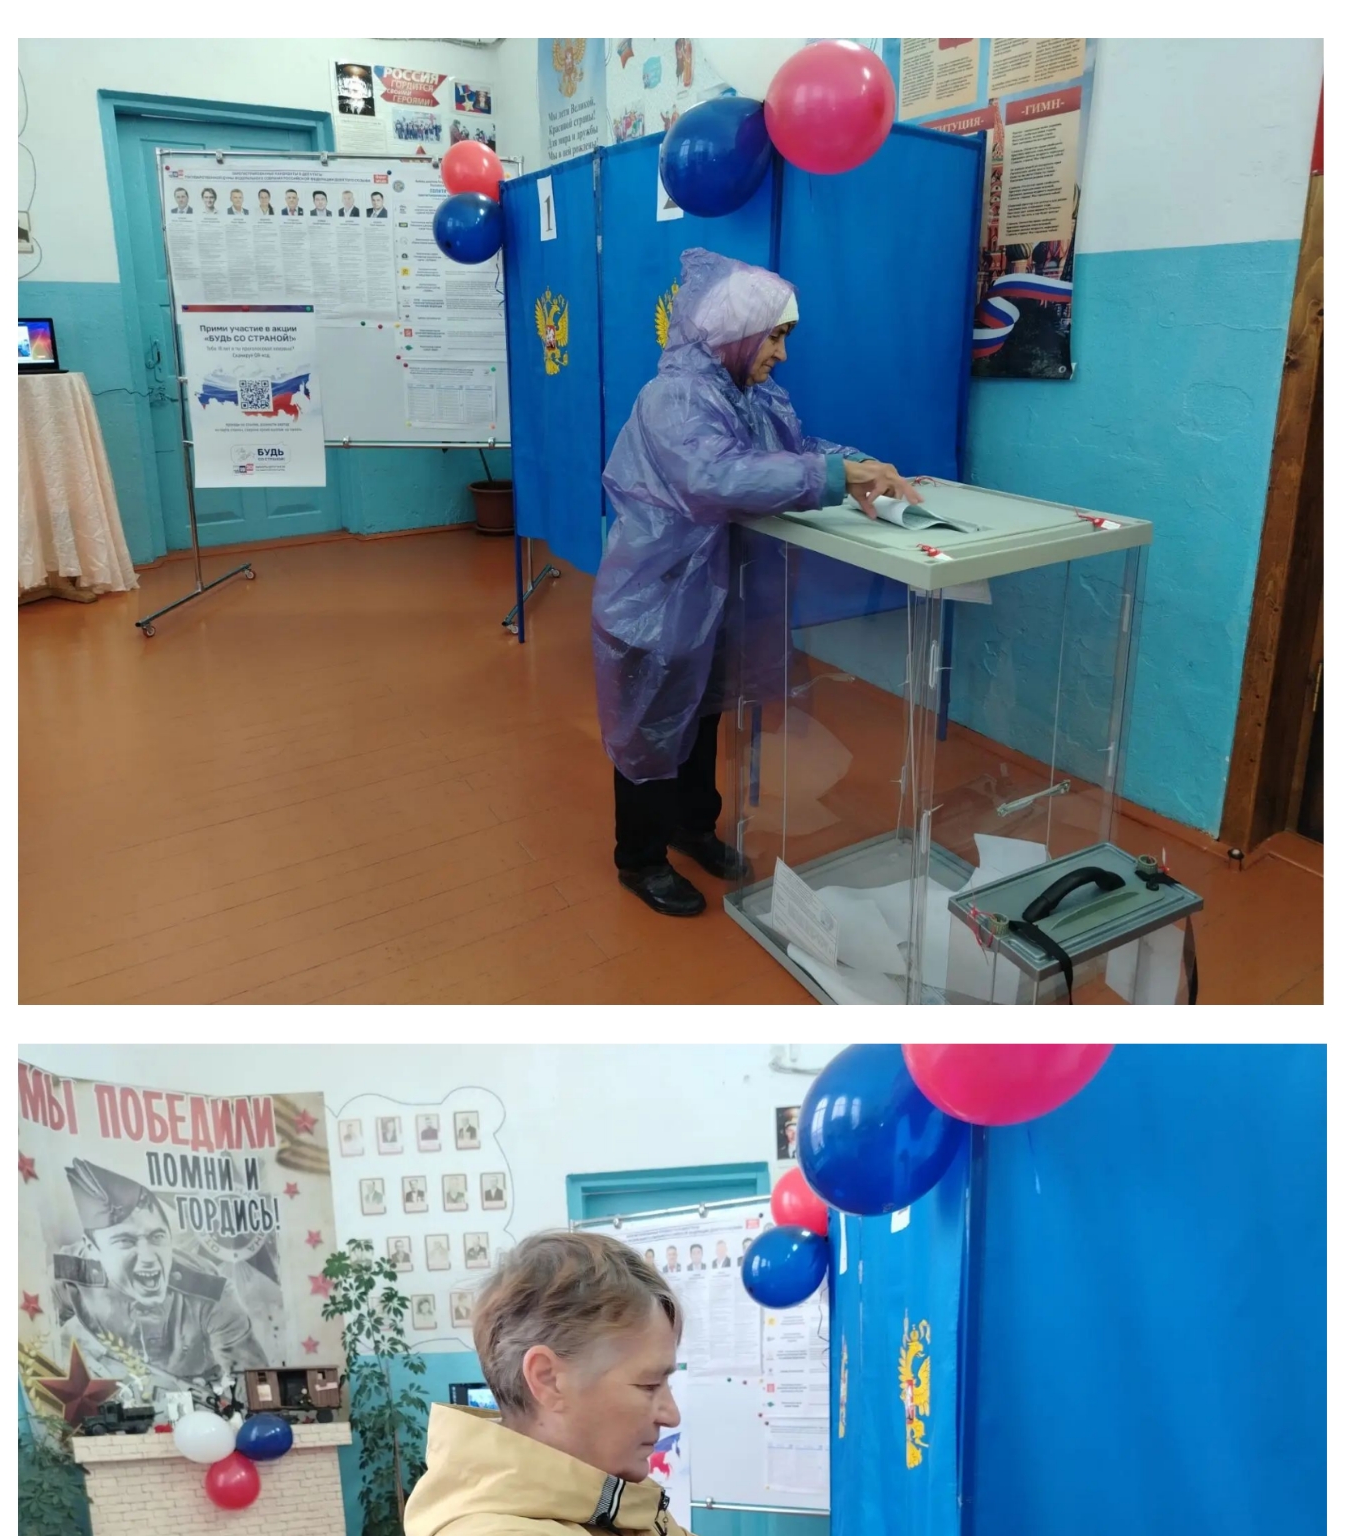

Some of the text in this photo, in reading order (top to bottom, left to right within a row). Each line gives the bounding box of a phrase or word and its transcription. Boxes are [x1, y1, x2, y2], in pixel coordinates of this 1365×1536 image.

[383, 67, 439, 84] РОССИЯ
[390, 80, 434, 92] ГОРДИТСЯ
[392, 95, 433, 107] ГЕРОЯМИ!
[1021, 98, 1066, 116] -ГИМН-
[548, 111, 558, 121] Мы
[548, 151, 558, 161] Мы
[544, 195, 554, 232] 1
[199, 325, 228, 333] Прими
[272, 326, 297, 334] акции
[204, 334, 232, 343] «БУДЬ
[248, 333, 297, 343] СТРАНОЙ!»
[257, 448, 284, 457] БУДЬ
[18, 1062, 276, 1153] МЫ ПОБЕДИЛИ
[146, 1151, 259, 1191] ПОМНИ И
[176, 1196, 281, 1236] ГОРДИСЬ!
